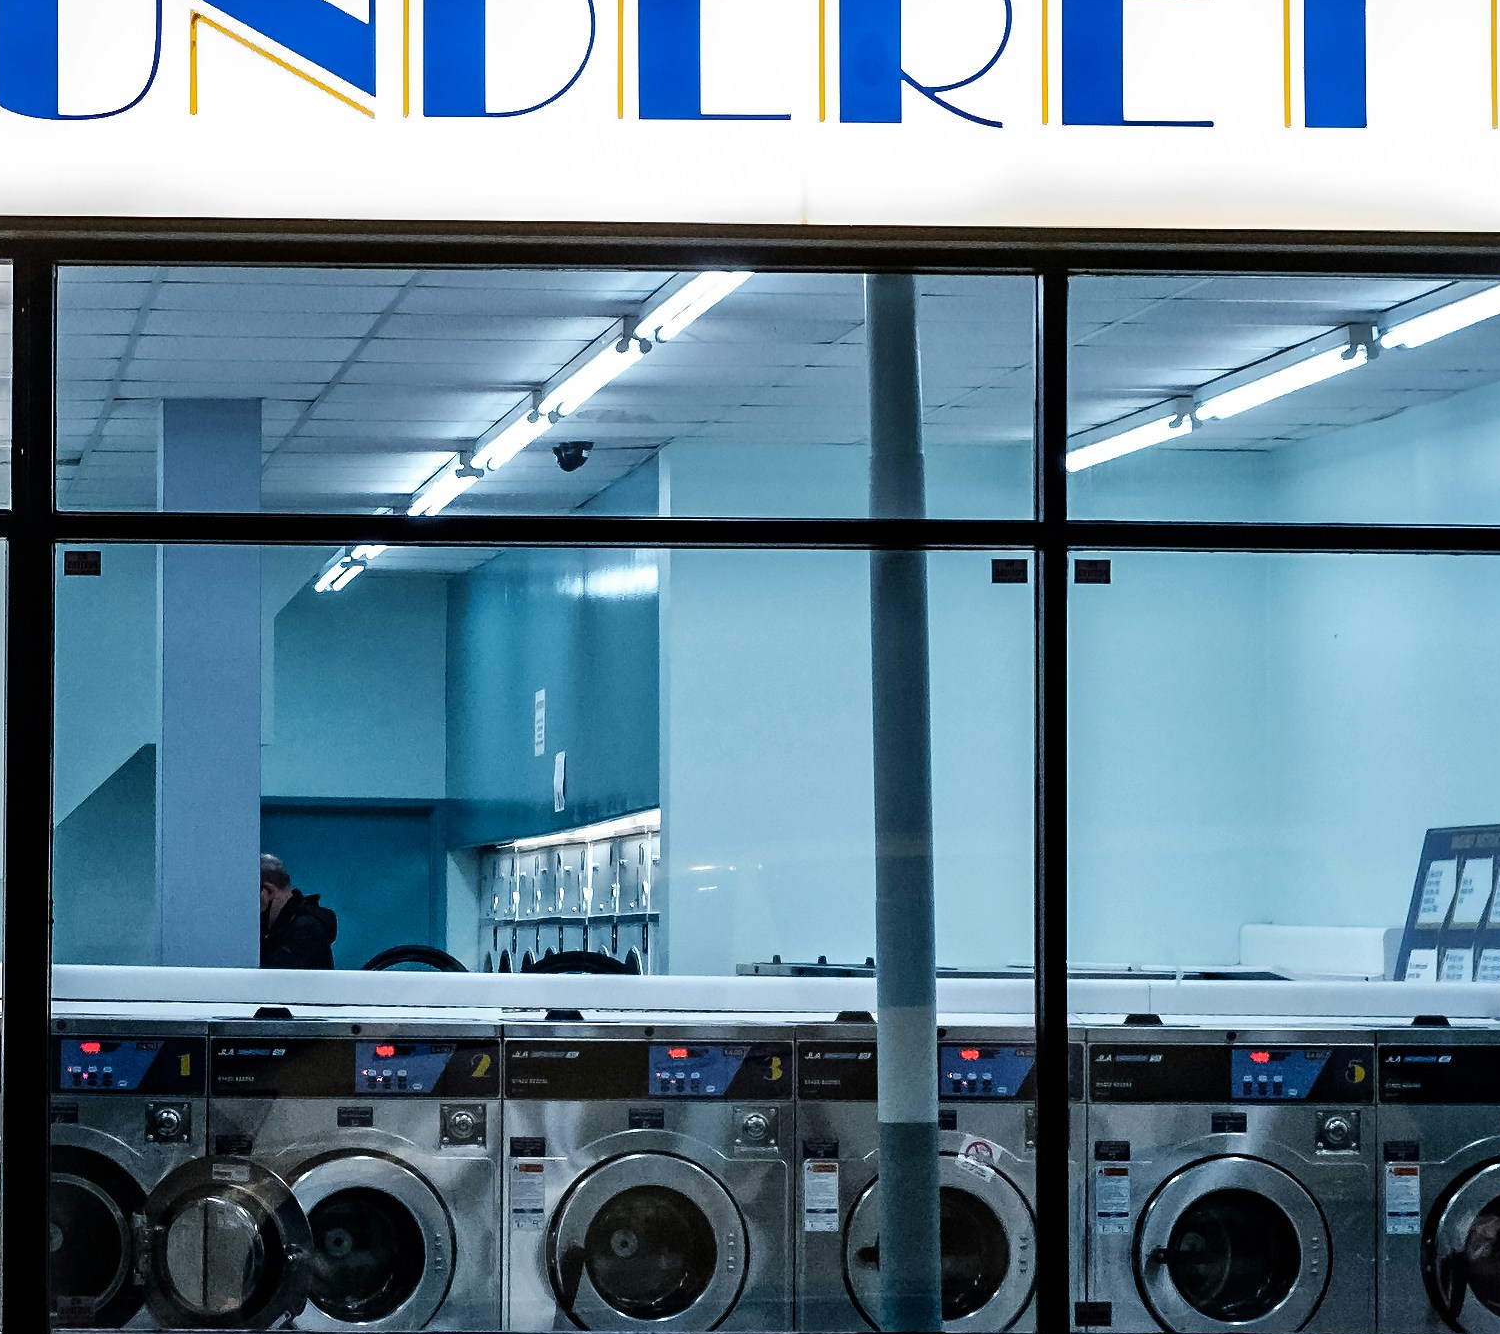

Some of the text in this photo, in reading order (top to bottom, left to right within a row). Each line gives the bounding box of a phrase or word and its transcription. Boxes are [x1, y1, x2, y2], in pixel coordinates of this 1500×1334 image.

[177, 1053, 191, 1077] 1
[470, 1053, 492, 1078] 2
[762, 1055, 785, 1082] 3
[1345, 1060, 1366, 1084] 5
